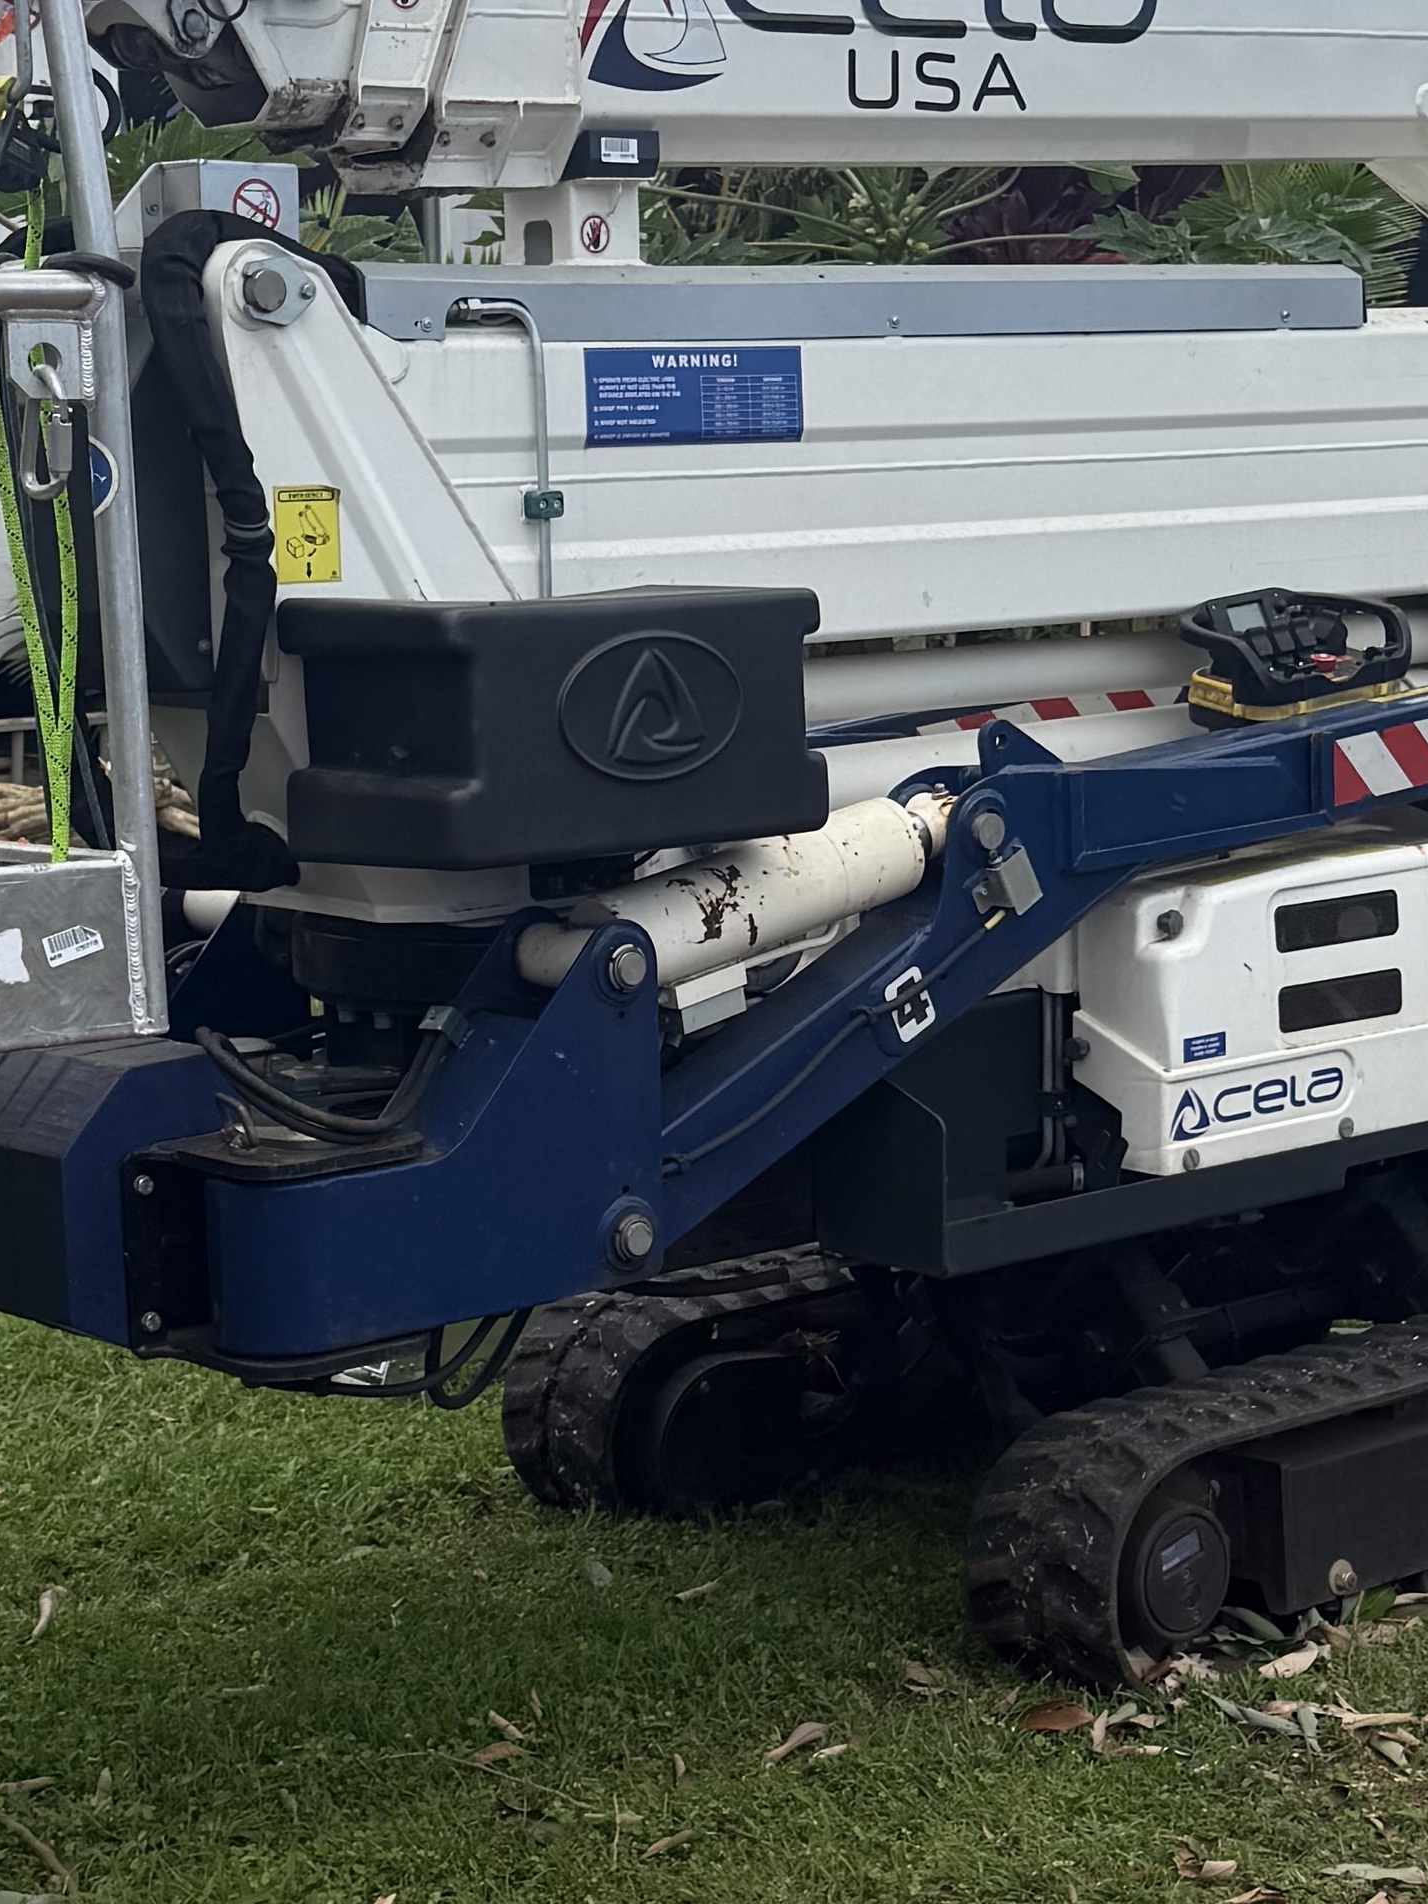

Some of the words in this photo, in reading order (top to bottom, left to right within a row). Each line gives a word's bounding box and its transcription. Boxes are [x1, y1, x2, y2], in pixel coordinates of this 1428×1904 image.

[848, 48, 1027, 112] USA
[651, 353, 739, 369] WARNING!
[896, 975, 930, 1030] 4
